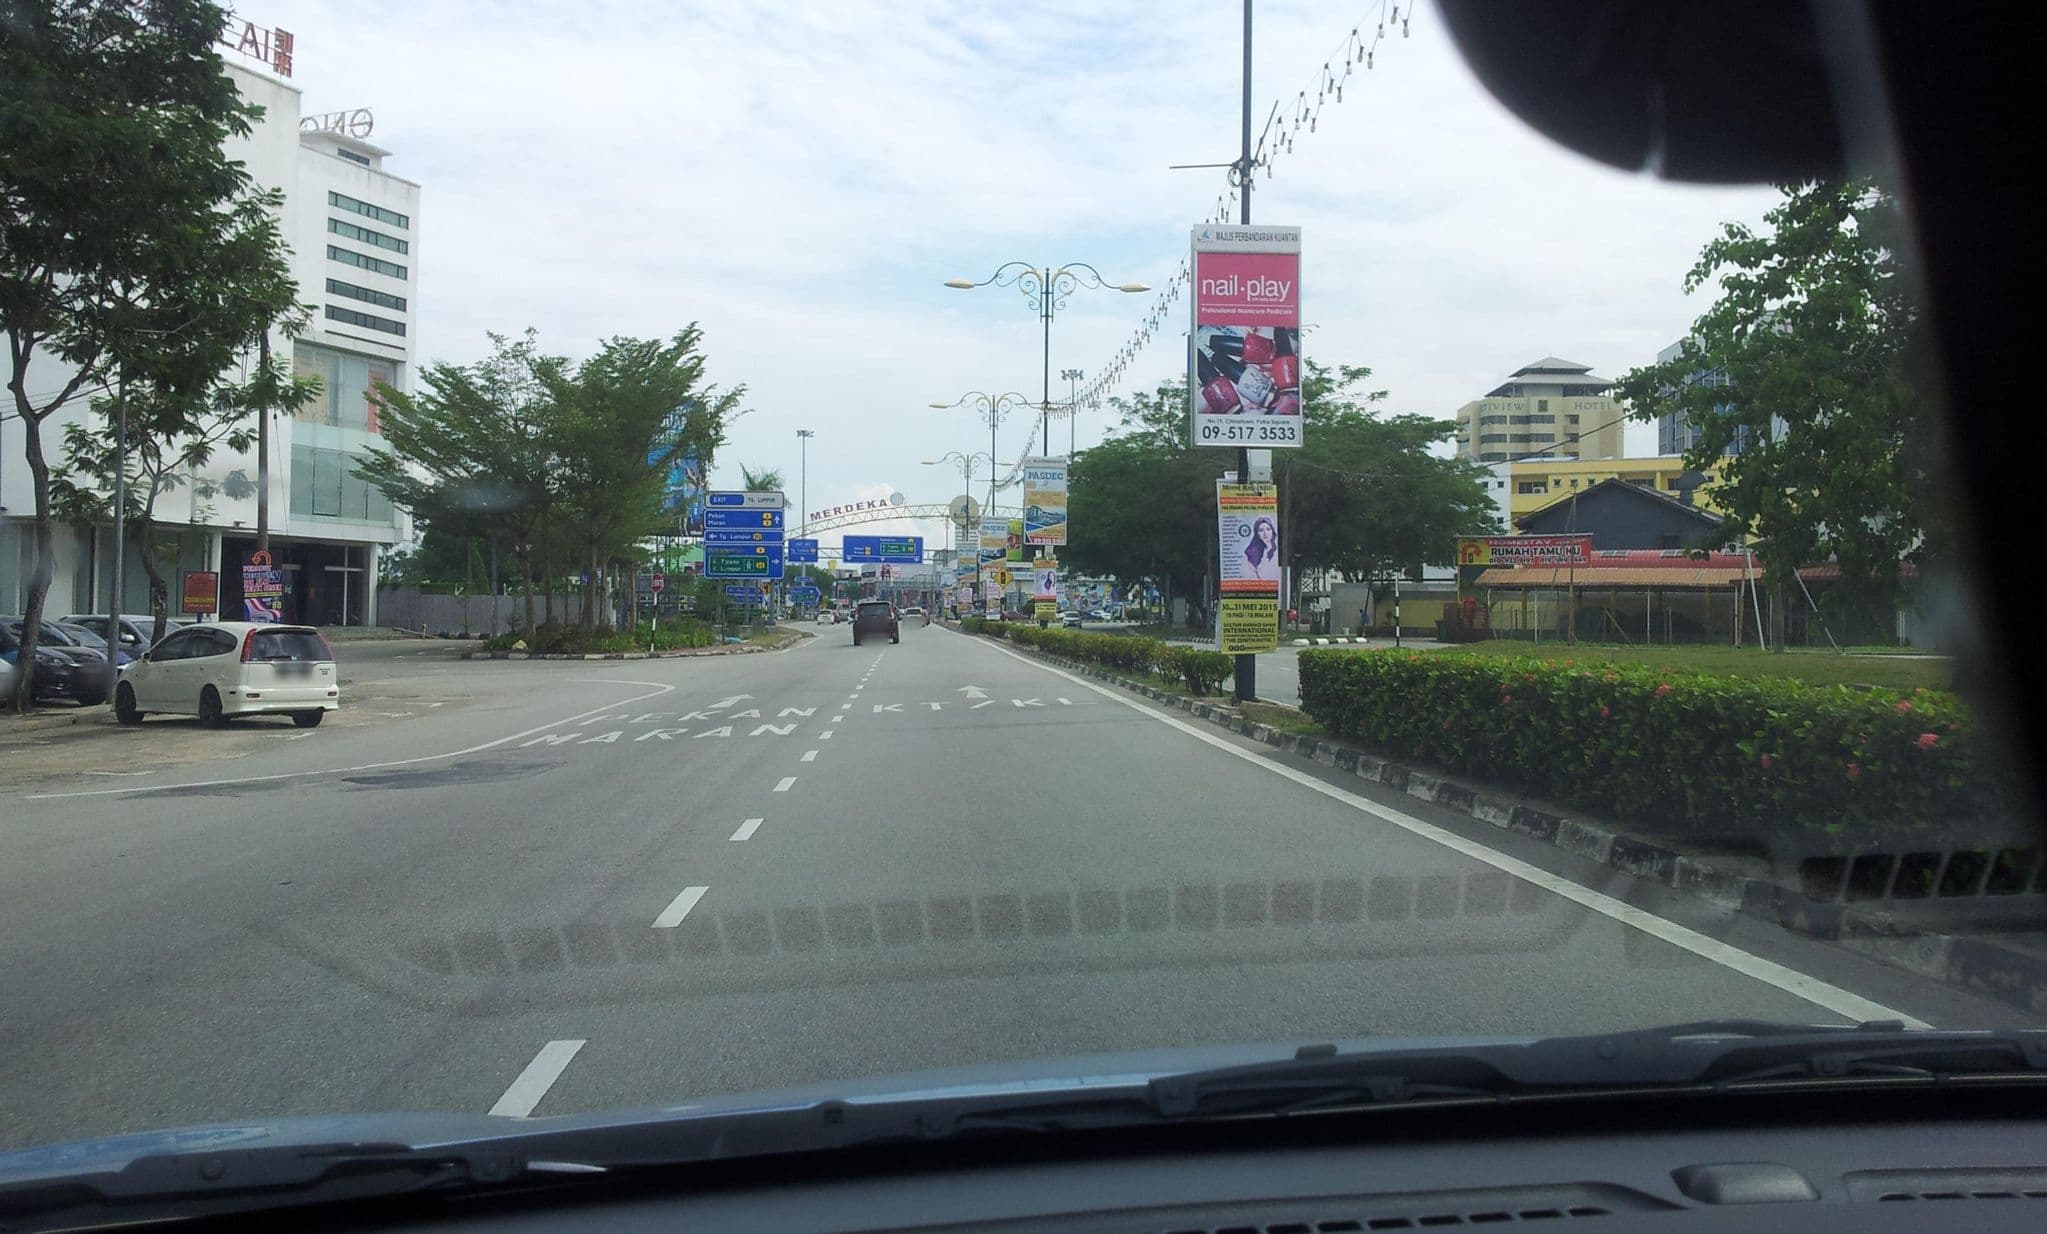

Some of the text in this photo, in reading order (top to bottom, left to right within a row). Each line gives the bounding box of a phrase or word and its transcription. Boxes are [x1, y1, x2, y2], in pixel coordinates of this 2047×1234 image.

[1216, 231, 1298, 242] MAJLIS PERBANDARAN KUANTAN
[1574, 402, 1612, 411] HOTEL
[1202, 426, 1295, 440] 09-517 3533
[1028, 471, 1064, 480] PASDEC
[810, 499, 888, 521] MERDEKA
[1491, 545, 1581, 556] RUMAH TAMU KU
[578, 707, 817, 726] PEKAN
[520, 723, 798, 747] MARAN
